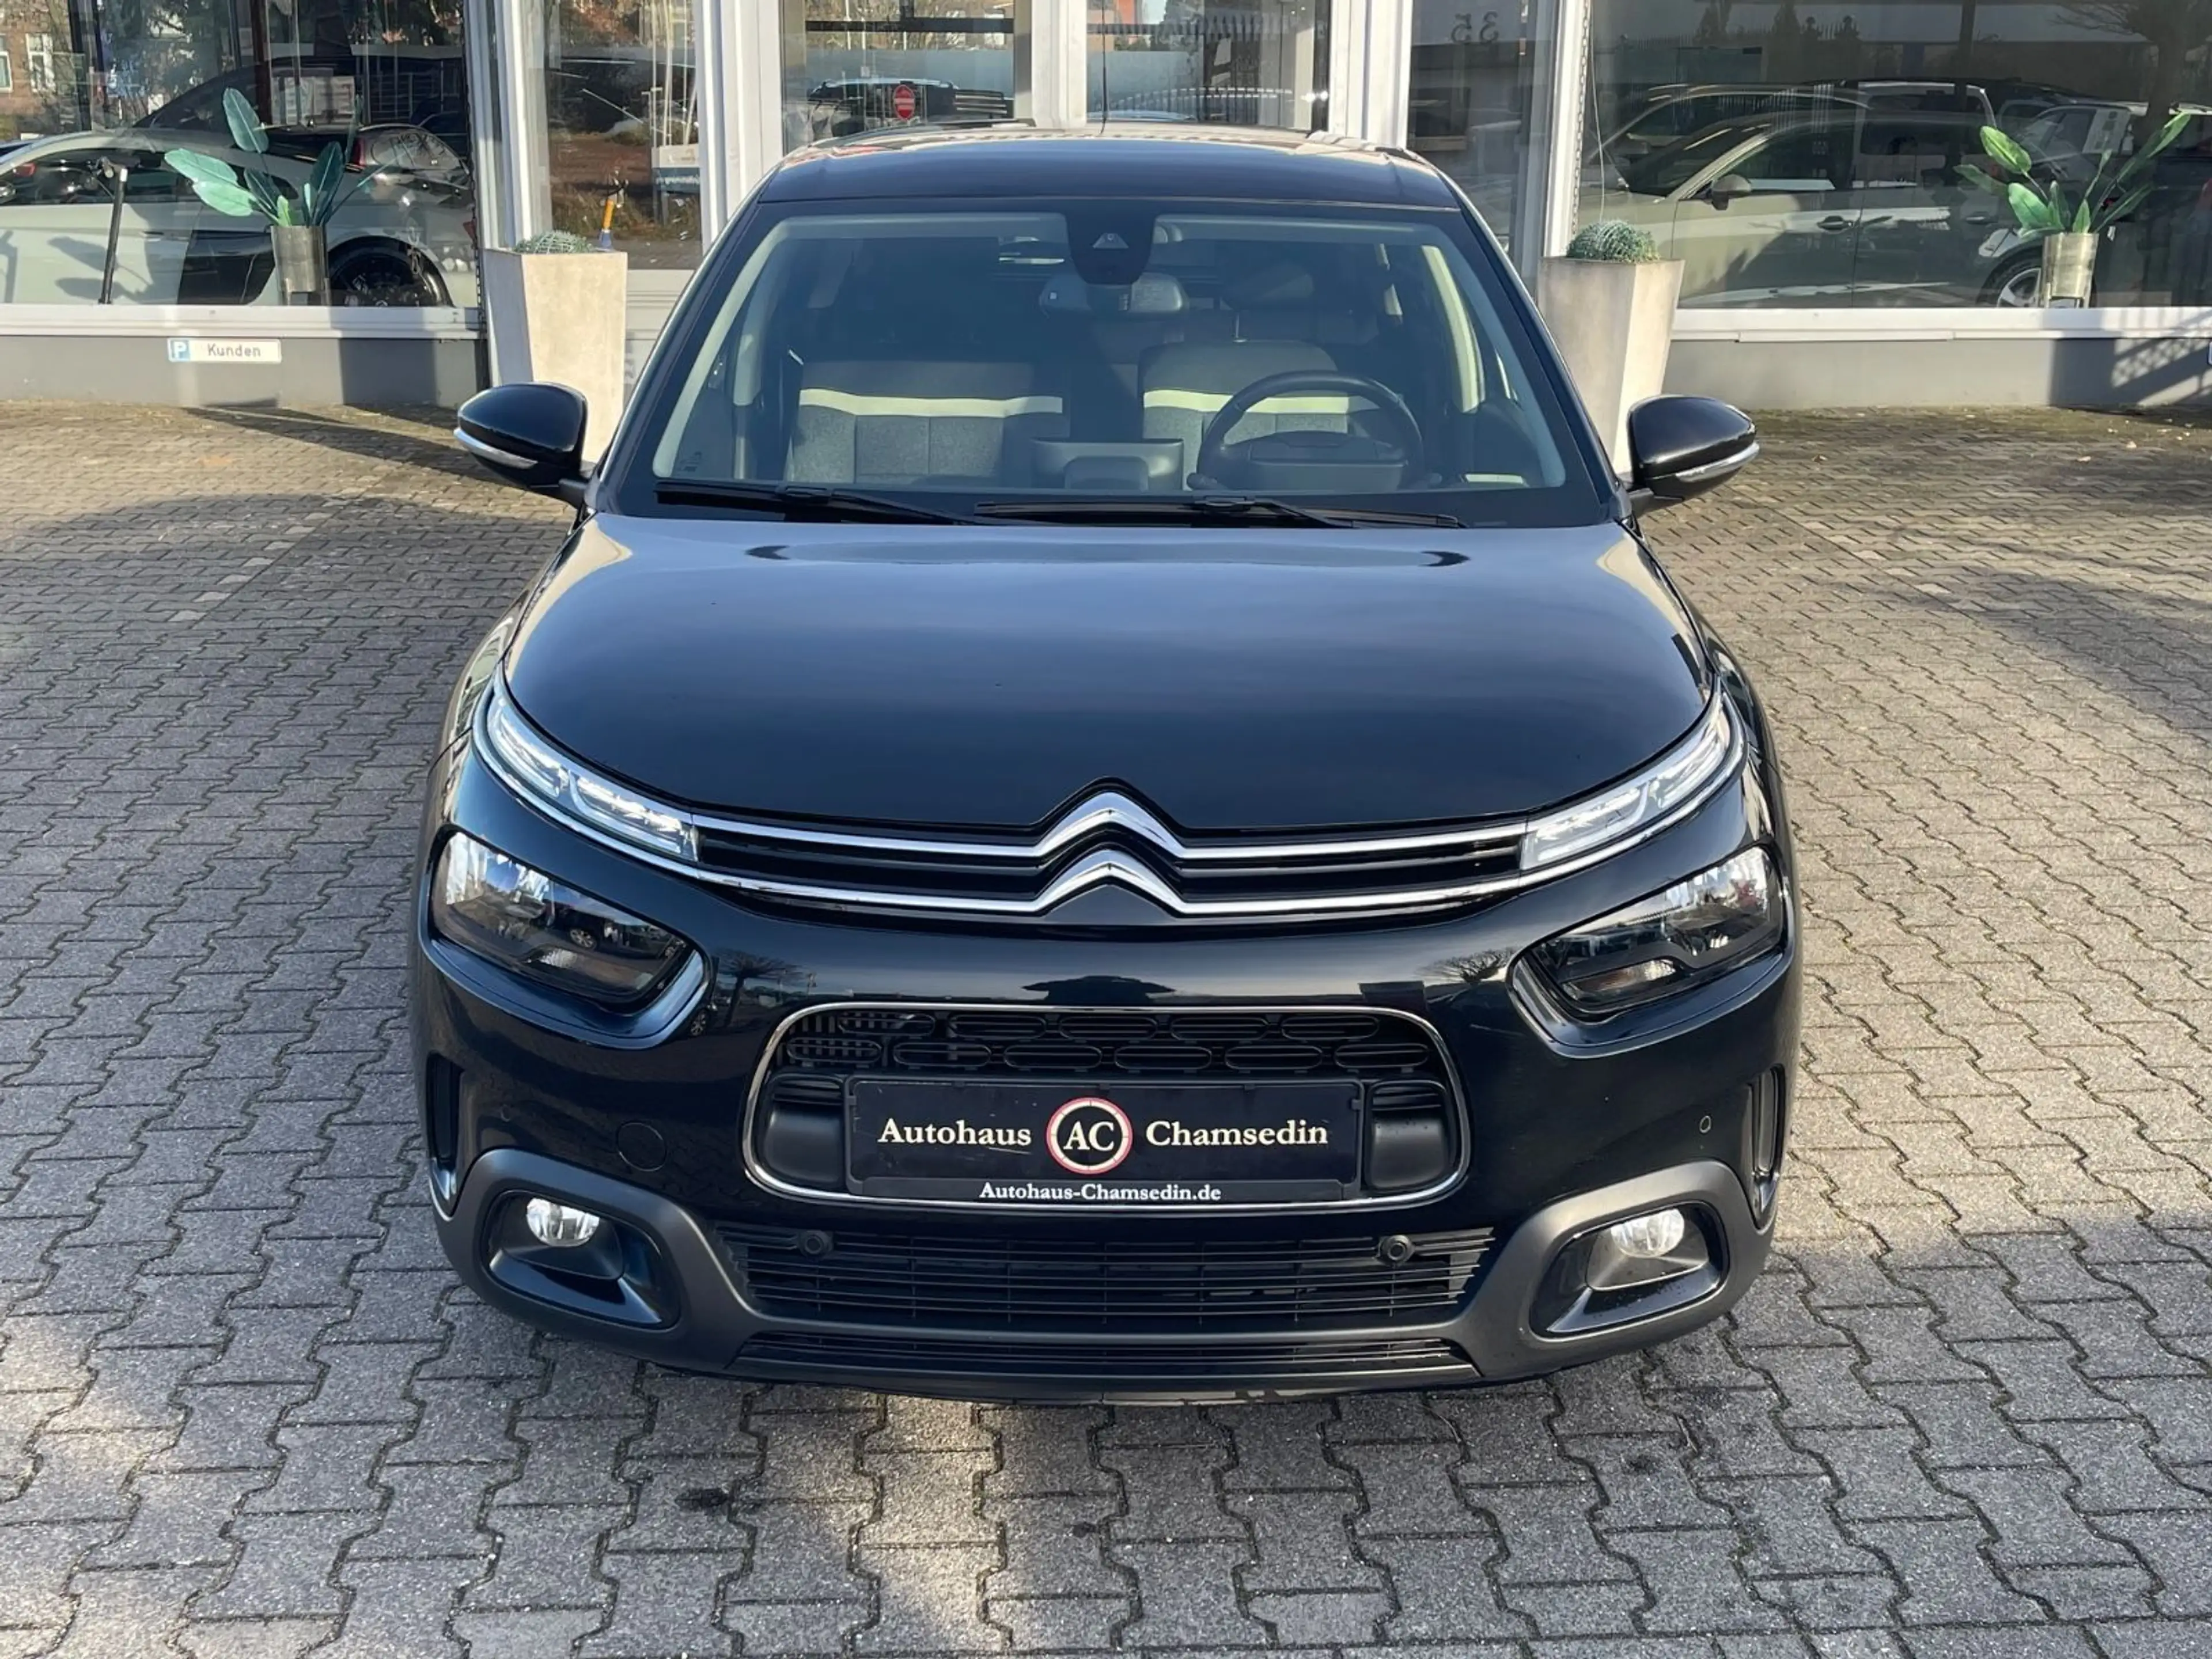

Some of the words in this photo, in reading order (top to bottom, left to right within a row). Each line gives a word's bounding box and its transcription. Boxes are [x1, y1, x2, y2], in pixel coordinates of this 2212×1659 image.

[173, 340, 188, 358] P
[207, 343, 261, 357] Kunden
[877, 1118, 1032, 1146] Autohaus
[1063, 1120, 1115, 1152] AC
[1146, 1119, 1328, 1147] Chamsedin
[979, 1181, 1222, 1201] Autohaus-Chamsedin.de
